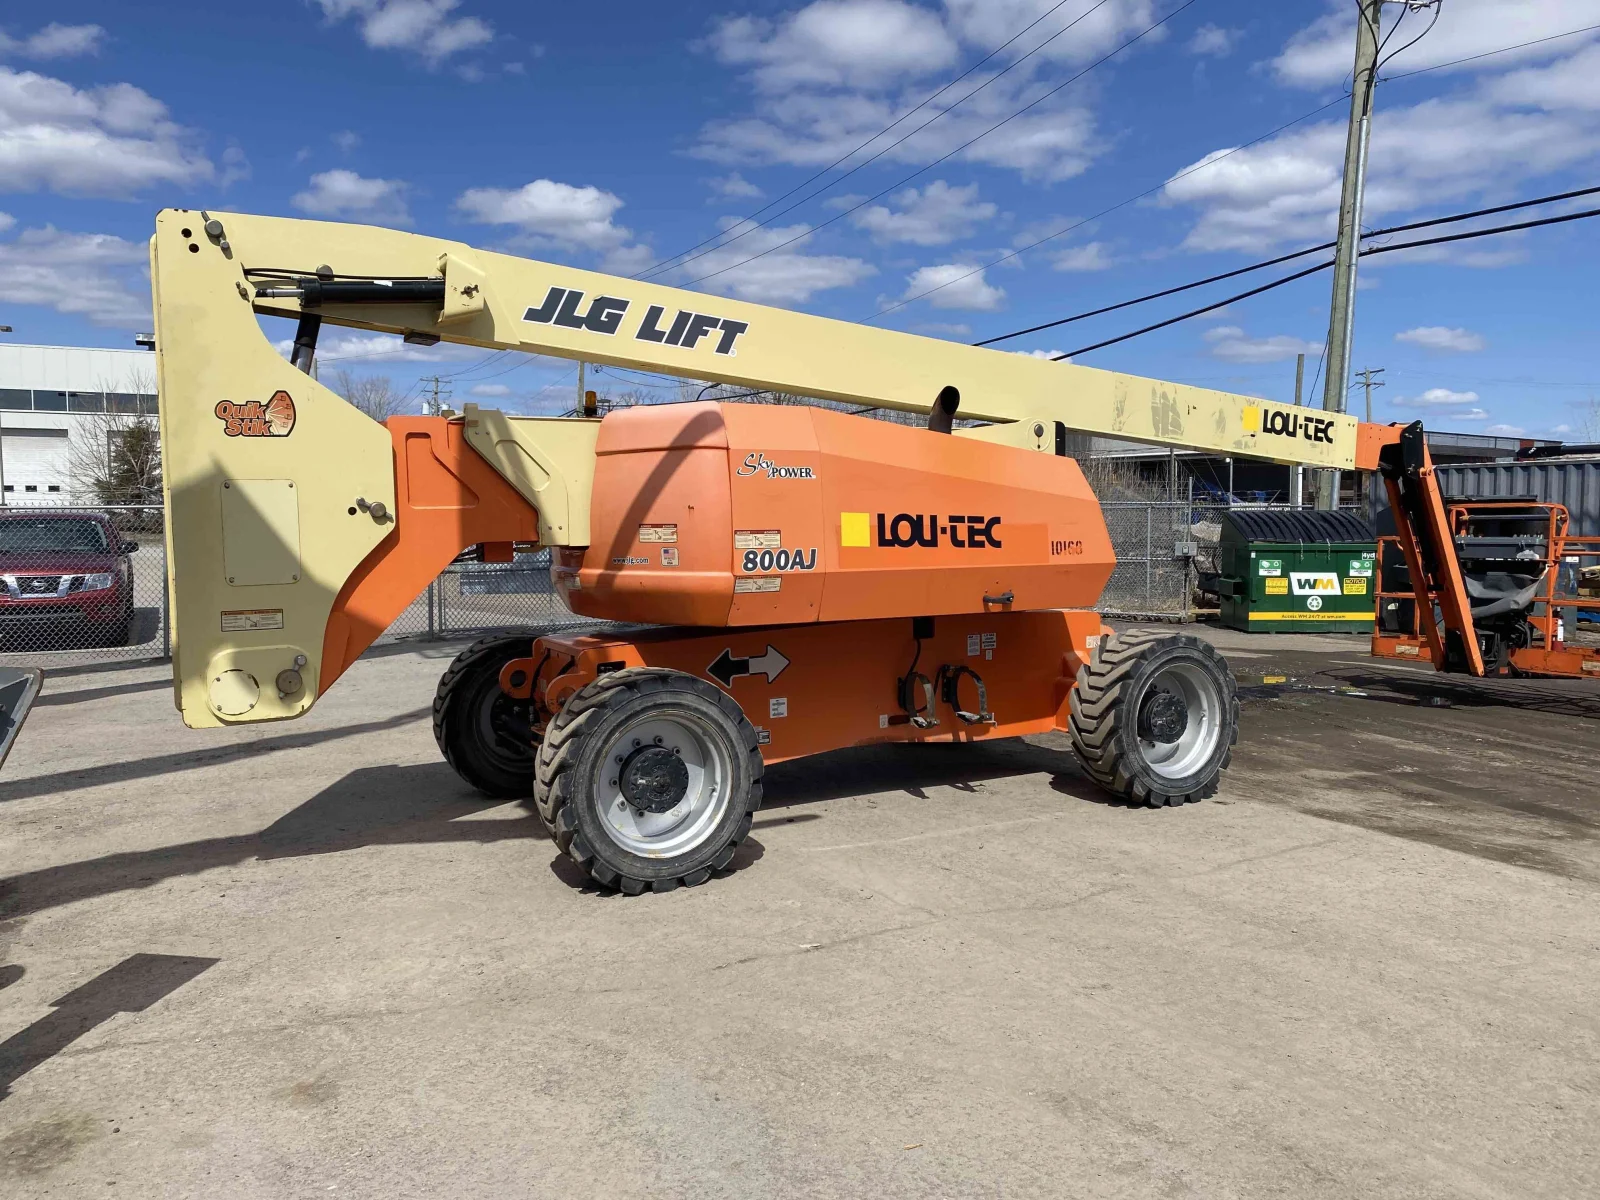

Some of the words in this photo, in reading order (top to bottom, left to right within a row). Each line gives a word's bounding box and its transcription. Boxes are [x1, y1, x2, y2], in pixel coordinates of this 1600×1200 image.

[522, 286, 631, 335] JLG
[635, 304, 748, 355] LIFT
[215, 400, 267, 420] Quik
[225, 418, 271, 436] Stik
[736, 453, 774, 479] Sky
[771, 467, 813, 478] POWER
[612, 556, 650, 565] www.jlg.com
[742, 548, 817, 572] 800AJ
[1296, 578, 1336, 590] WM
